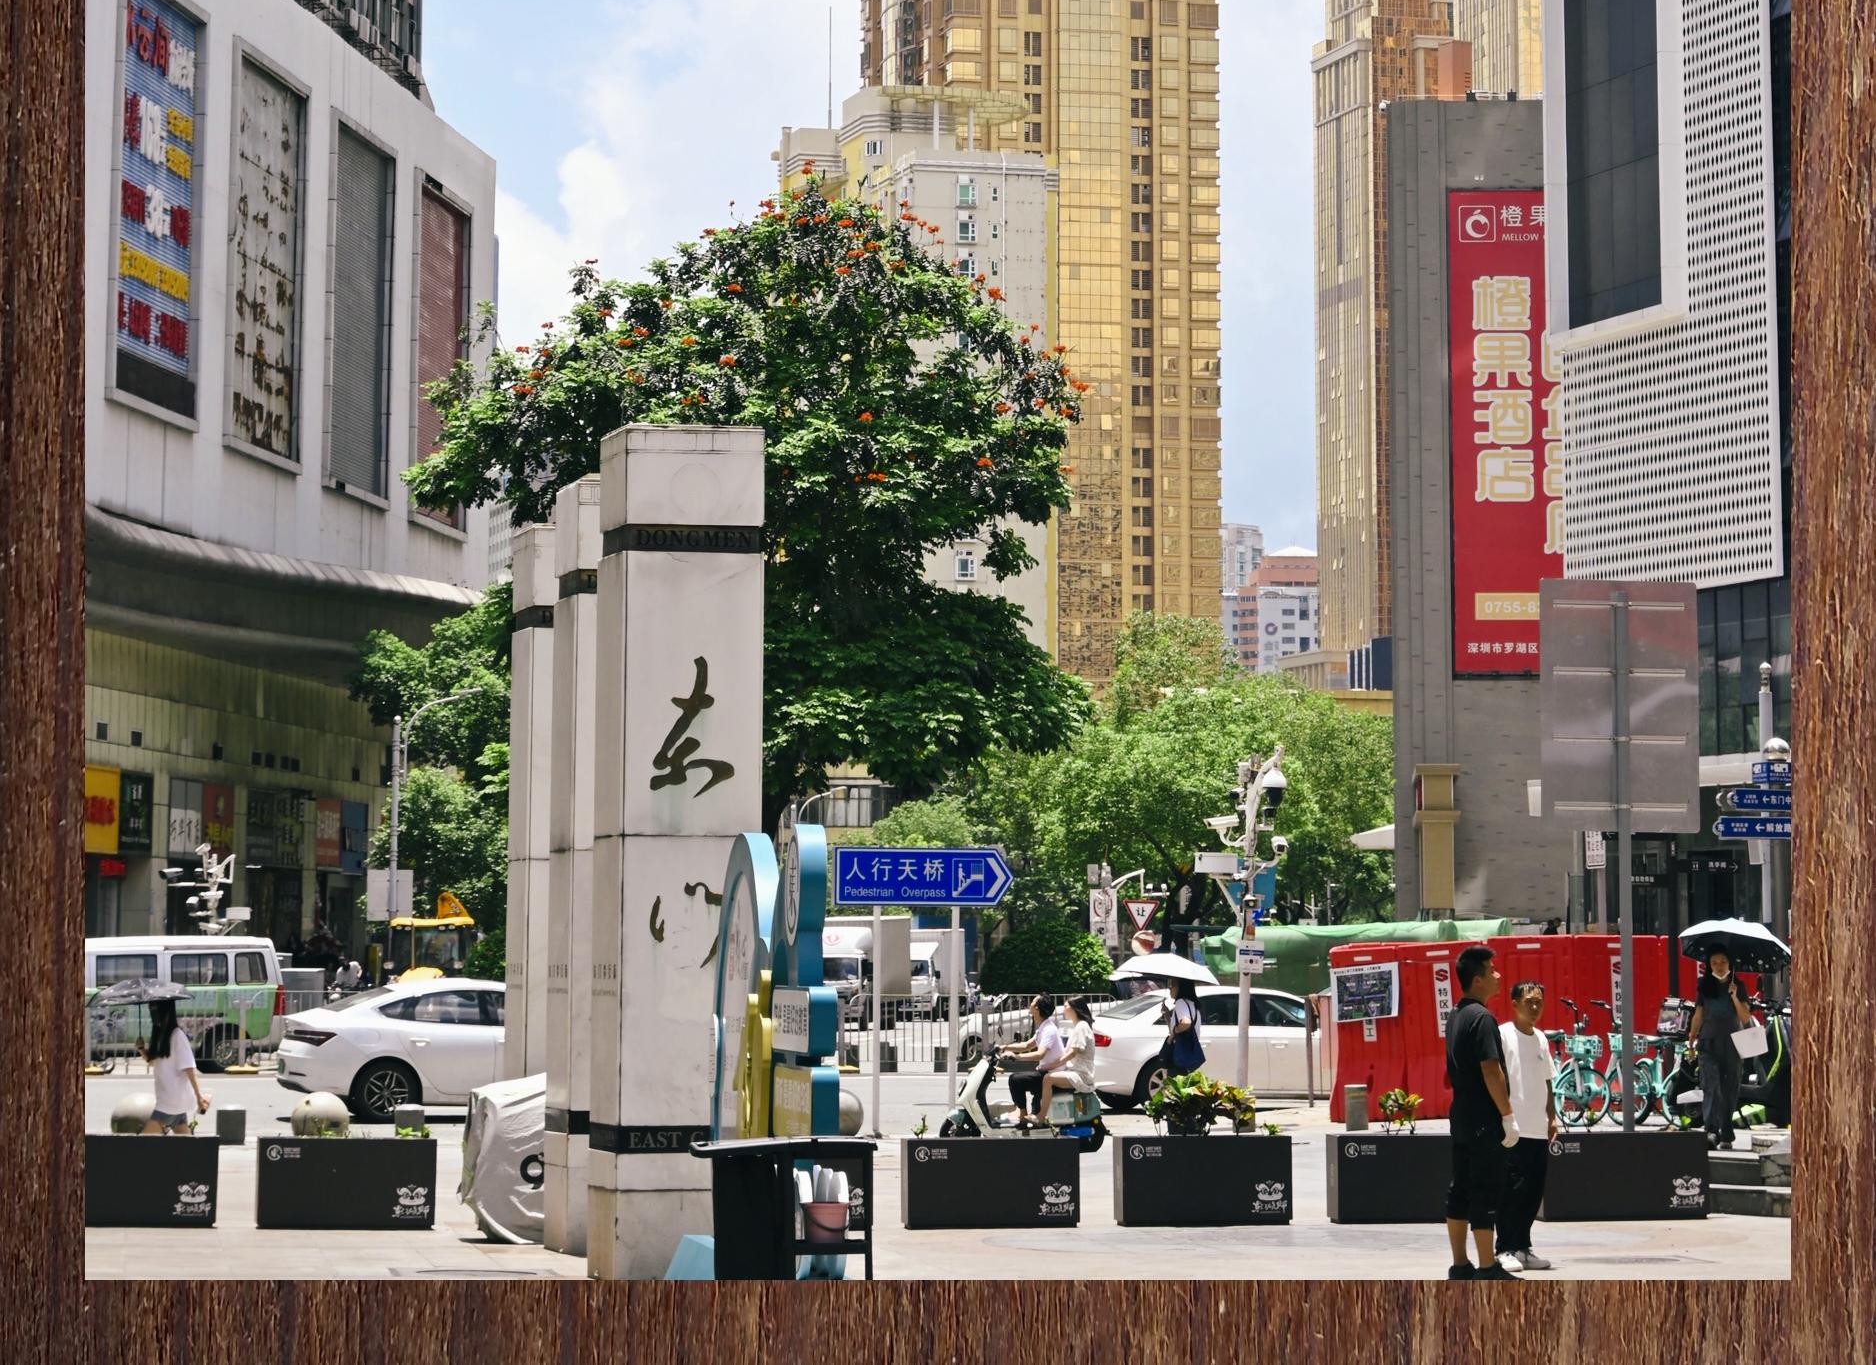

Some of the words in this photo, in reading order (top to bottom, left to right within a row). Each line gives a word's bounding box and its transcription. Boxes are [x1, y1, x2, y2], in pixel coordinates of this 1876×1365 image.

[1502, 233, 1539, 242] MELLOW
[1472, 275, 1534, 502] 橙果酒店
[635, 529, 751, 549] DONGMEN
[1484, 601, 1540, 614] 0755-8
[1467, 642, 1539, 654] 深圳市罗湖区
[845, 857, 944, 882] 人行天桥
[844, 887, 894, 897] Pedestrian
[901, 887, 946, 899] Overpass
[1136, 906, 1145, 917] 让
[628, 1132, 683, 1149] EAST
